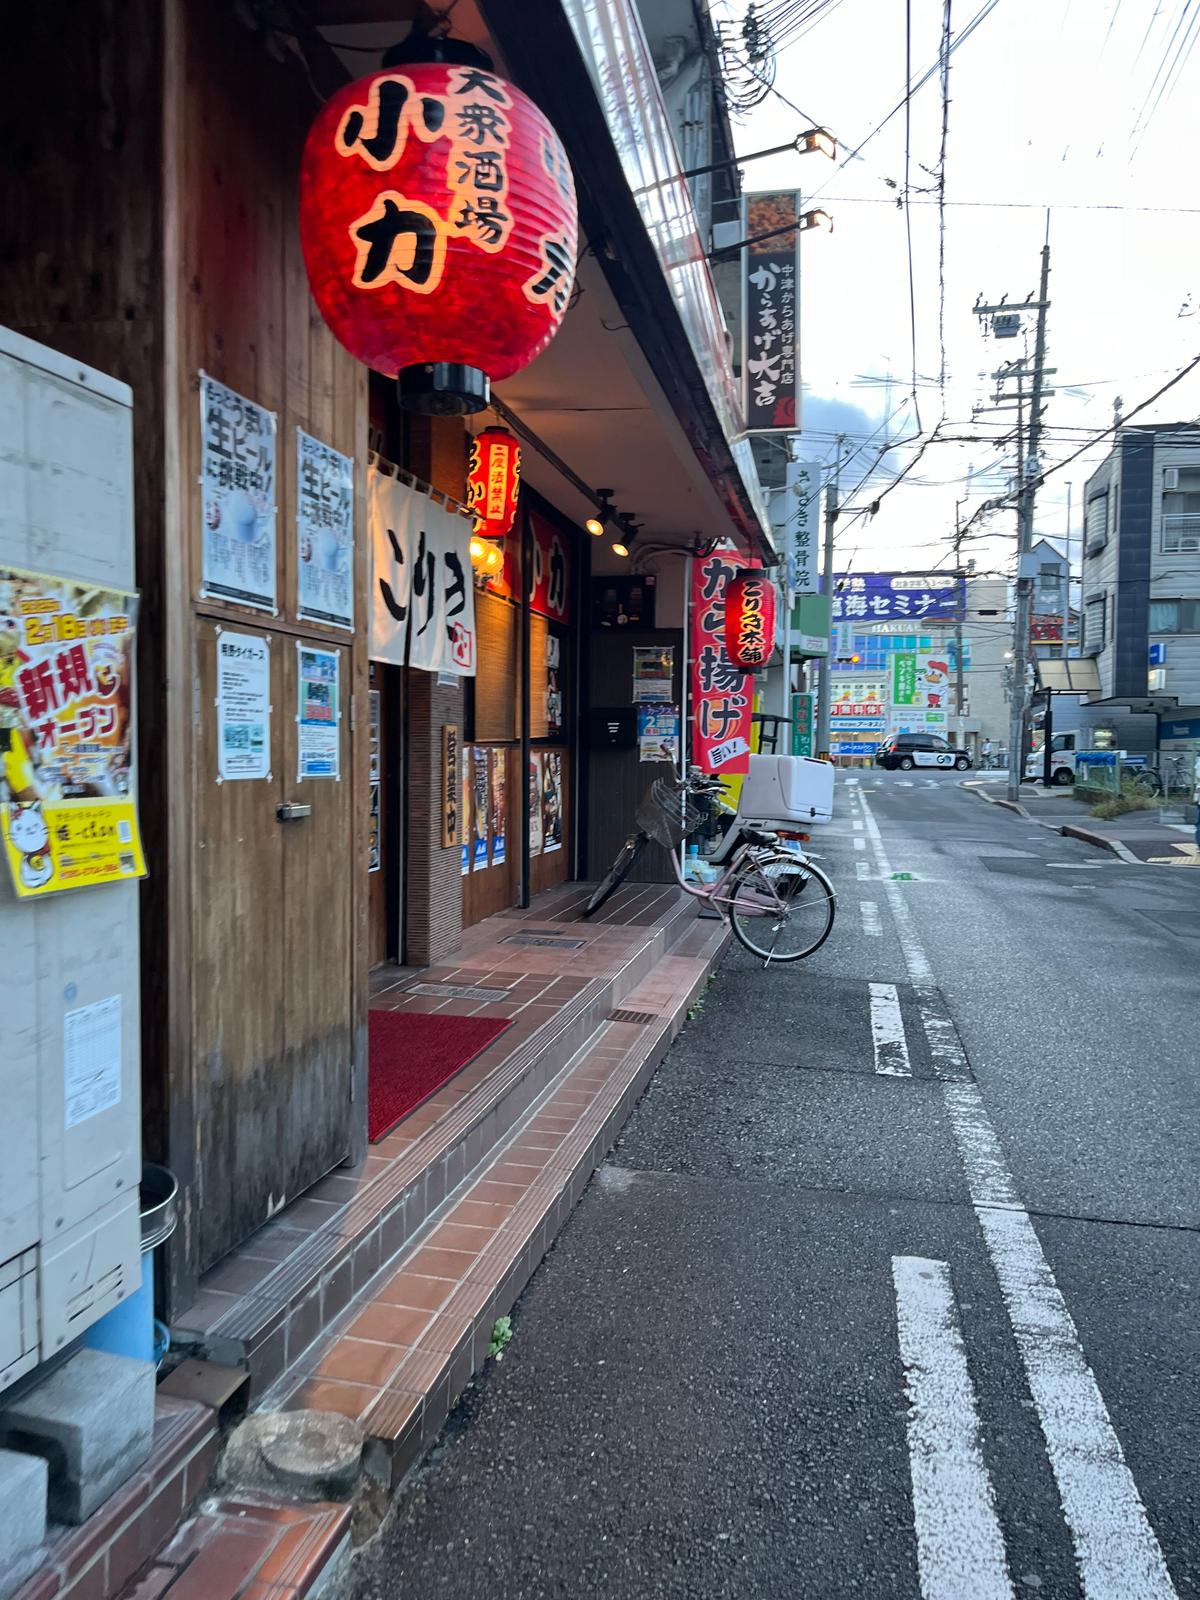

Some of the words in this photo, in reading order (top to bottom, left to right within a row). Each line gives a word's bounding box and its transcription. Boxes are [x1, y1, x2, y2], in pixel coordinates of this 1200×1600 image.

[343, 80, 445, 285] 小力
[455, 70, 508, 244] 大衆酒場
[748, 262, 781, 406] からあげ大吉
[780, 264, 795, 385] 中津からあげ専門店
[207, 407, 272, 473] 生ビール
[739, 581, 763, 662] こりき本舗
[833, 577, 866, 592] 学塾
[19, 644, 92, 719] 新規
[38, 706, 115, 748] オープン
[937, 754, 952, 764] GO
